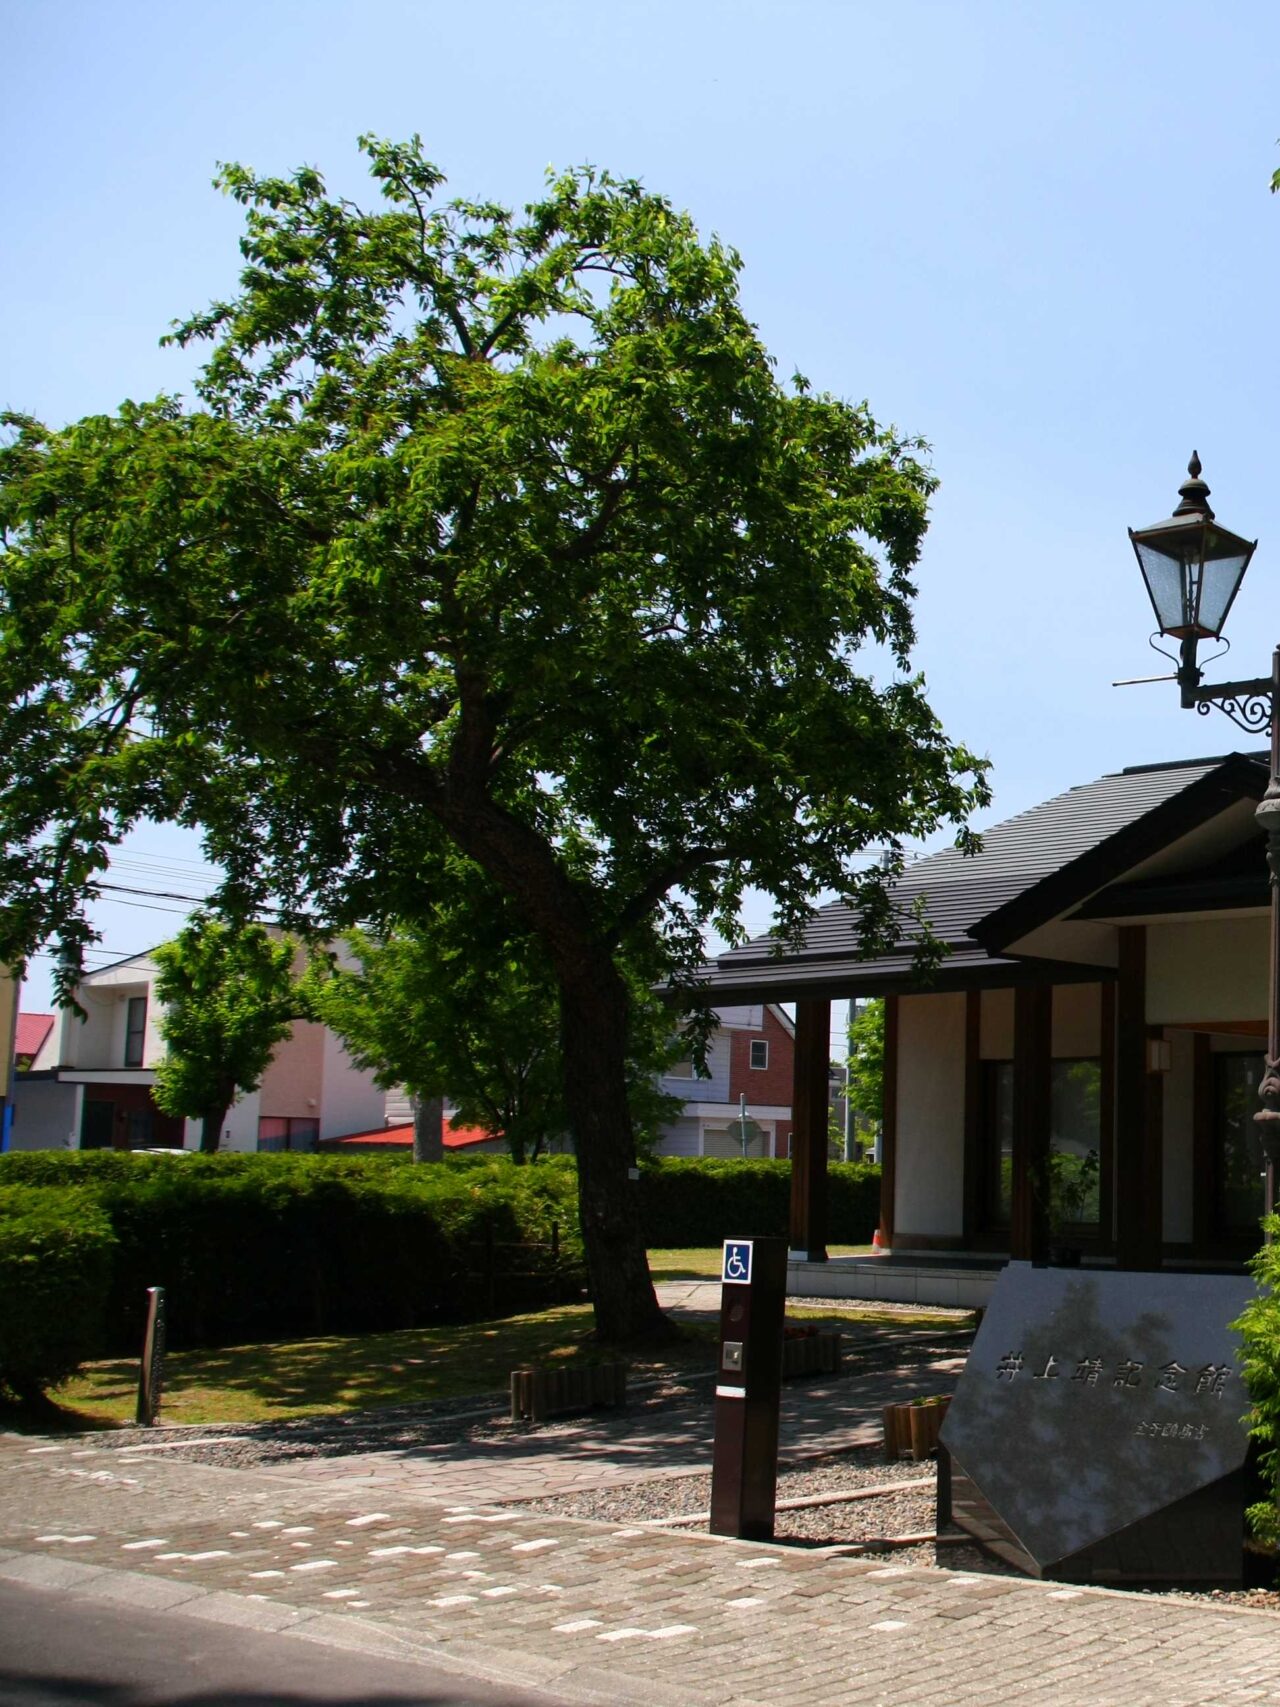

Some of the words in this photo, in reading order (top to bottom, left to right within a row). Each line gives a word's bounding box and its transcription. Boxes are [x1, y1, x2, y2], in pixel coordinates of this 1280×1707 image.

[996, 1351, 1233, 1400] 井上靖記念館
